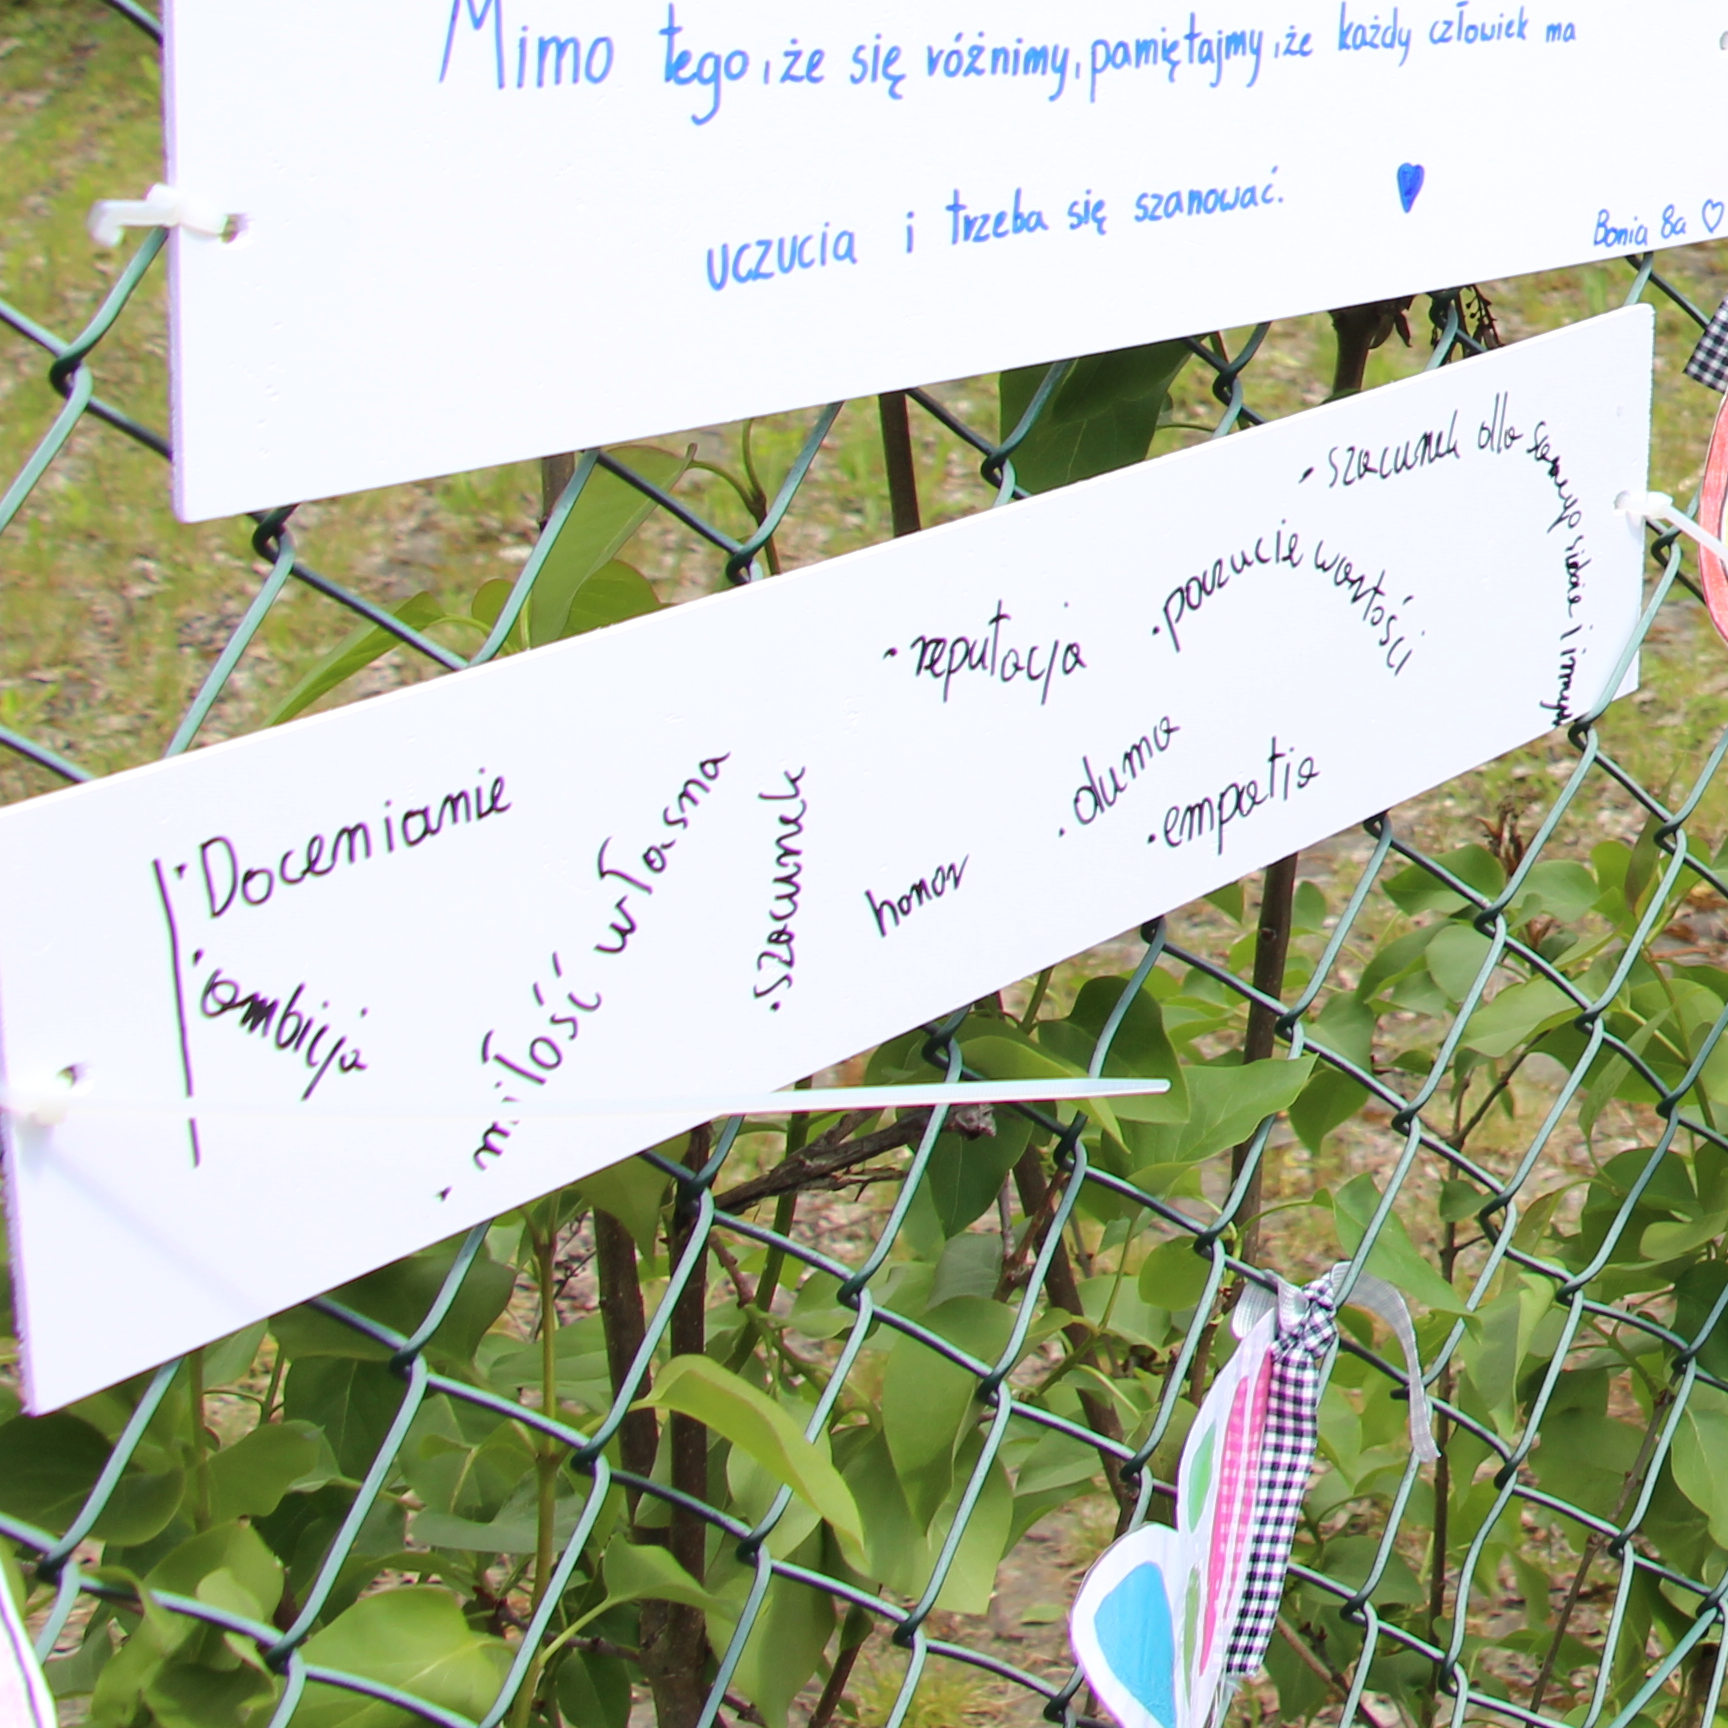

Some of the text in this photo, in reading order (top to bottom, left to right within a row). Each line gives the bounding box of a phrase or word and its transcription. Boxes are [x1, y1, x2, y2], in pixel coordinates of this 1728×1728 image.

[849, 33, 906, 99] się
[1338, 1, 1412, 69] każdy
[1427, 0, 1528, 46] człowiek
[1545, 18, 1578, 44] ma
[706, 165, 1285, 292] uczucia i trzeba się szanować.
[1660, 204, 1686, 239] 8a
[1328, 409, 1460, 489] szacunek
[1163, 519, 1303, 652] poczucie
[912, 597, 1087, 705] reputacja
[1072, 715, 1182, 826] duma
[1162, 736, 1321, 856] empatia
[200, 767, 512, 919] Docenianie
[753, 766, 806, 1000] szacunek
[864, 854, 971, 938] honor
